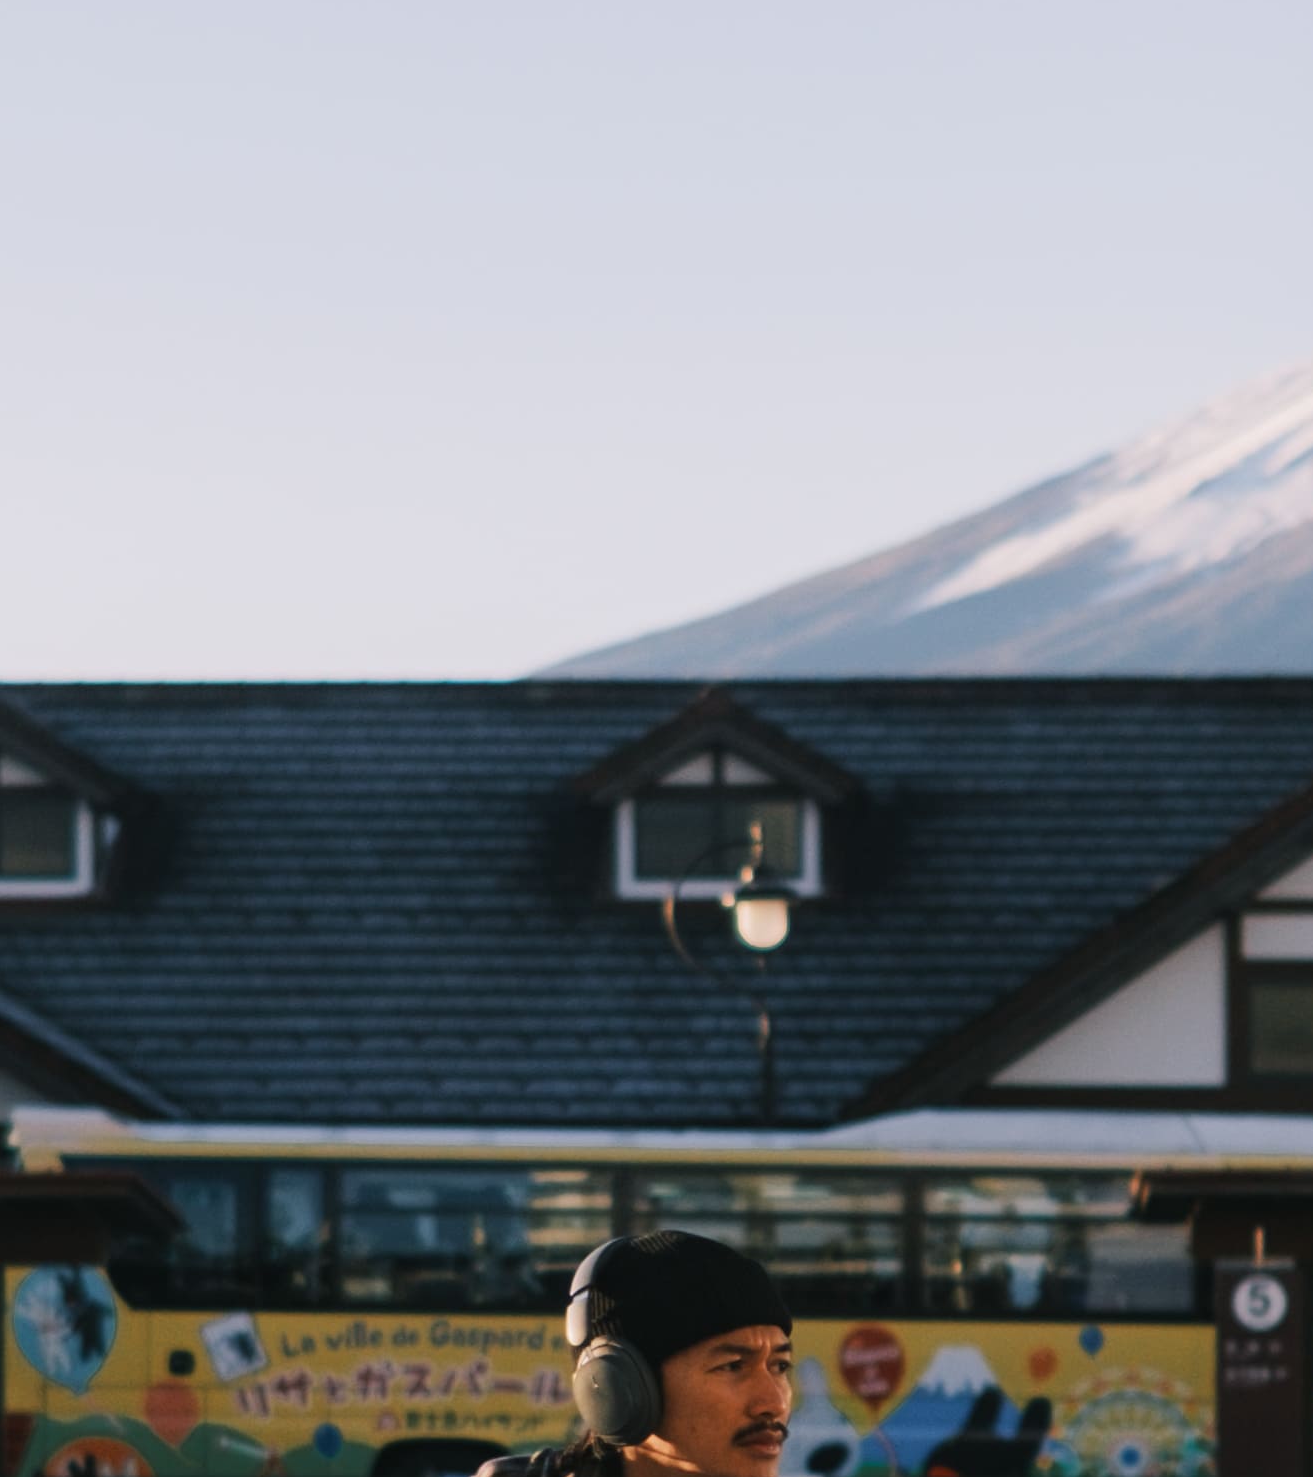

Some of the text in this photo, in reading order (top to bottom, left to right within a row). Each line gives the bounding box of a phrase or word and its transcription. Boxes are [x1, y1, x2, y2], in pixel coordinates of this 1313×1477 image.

[1247, 1281, 1273, 1317] 5
[430, 1319, 547, 1354] Gaspard
[238, 1359, 574, 1419] リサとガスパール
